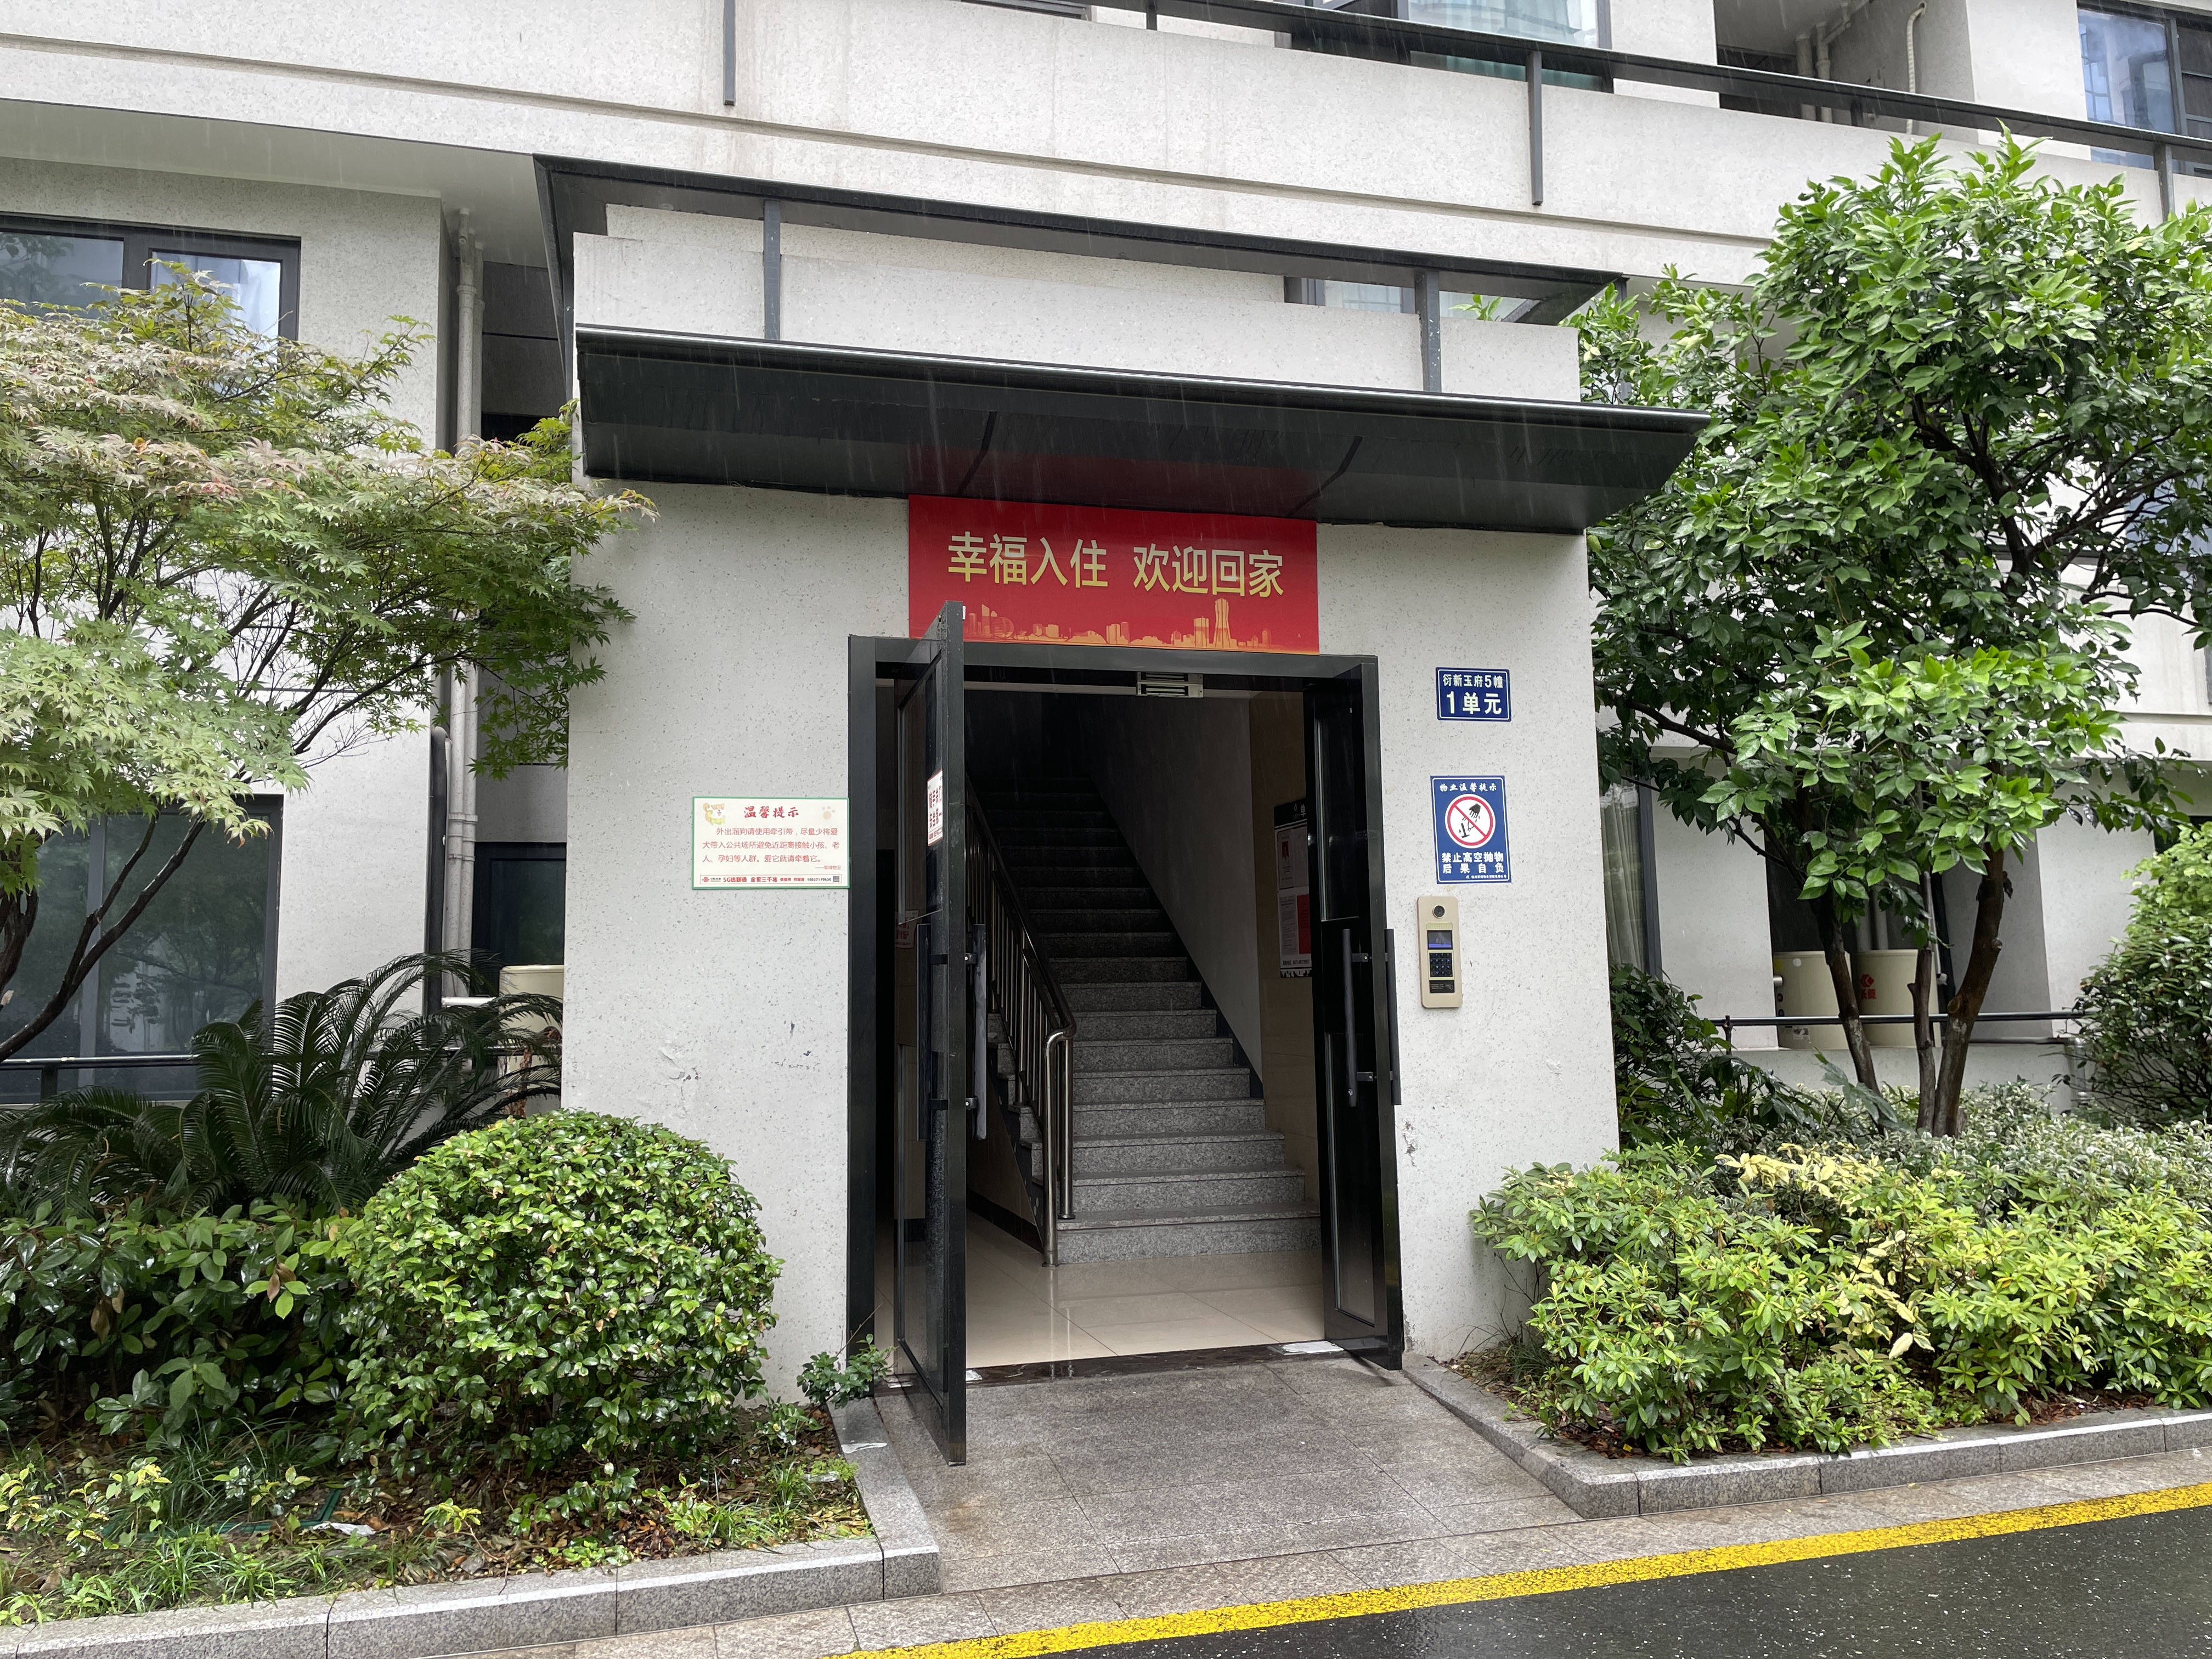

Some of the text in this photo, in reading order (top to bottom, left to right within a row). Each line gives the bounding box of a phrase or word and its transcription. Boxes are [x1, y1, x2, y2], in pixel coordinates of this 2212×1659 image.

[947, 531, 1284, 597] 幸福入住 欢迎回家
[1443, 674, 1503, 689] 衍新玉府5幢
[1446, 691, 1502, 714] 1单元
[1440, 782, 1497, 792] 物业温馨提示
[744, 806, 799, 819] 温馨提示
[1442, 851, 1504, 863] 禁止高空抛物
[1443, 862, 1504, 874] 后果自负
